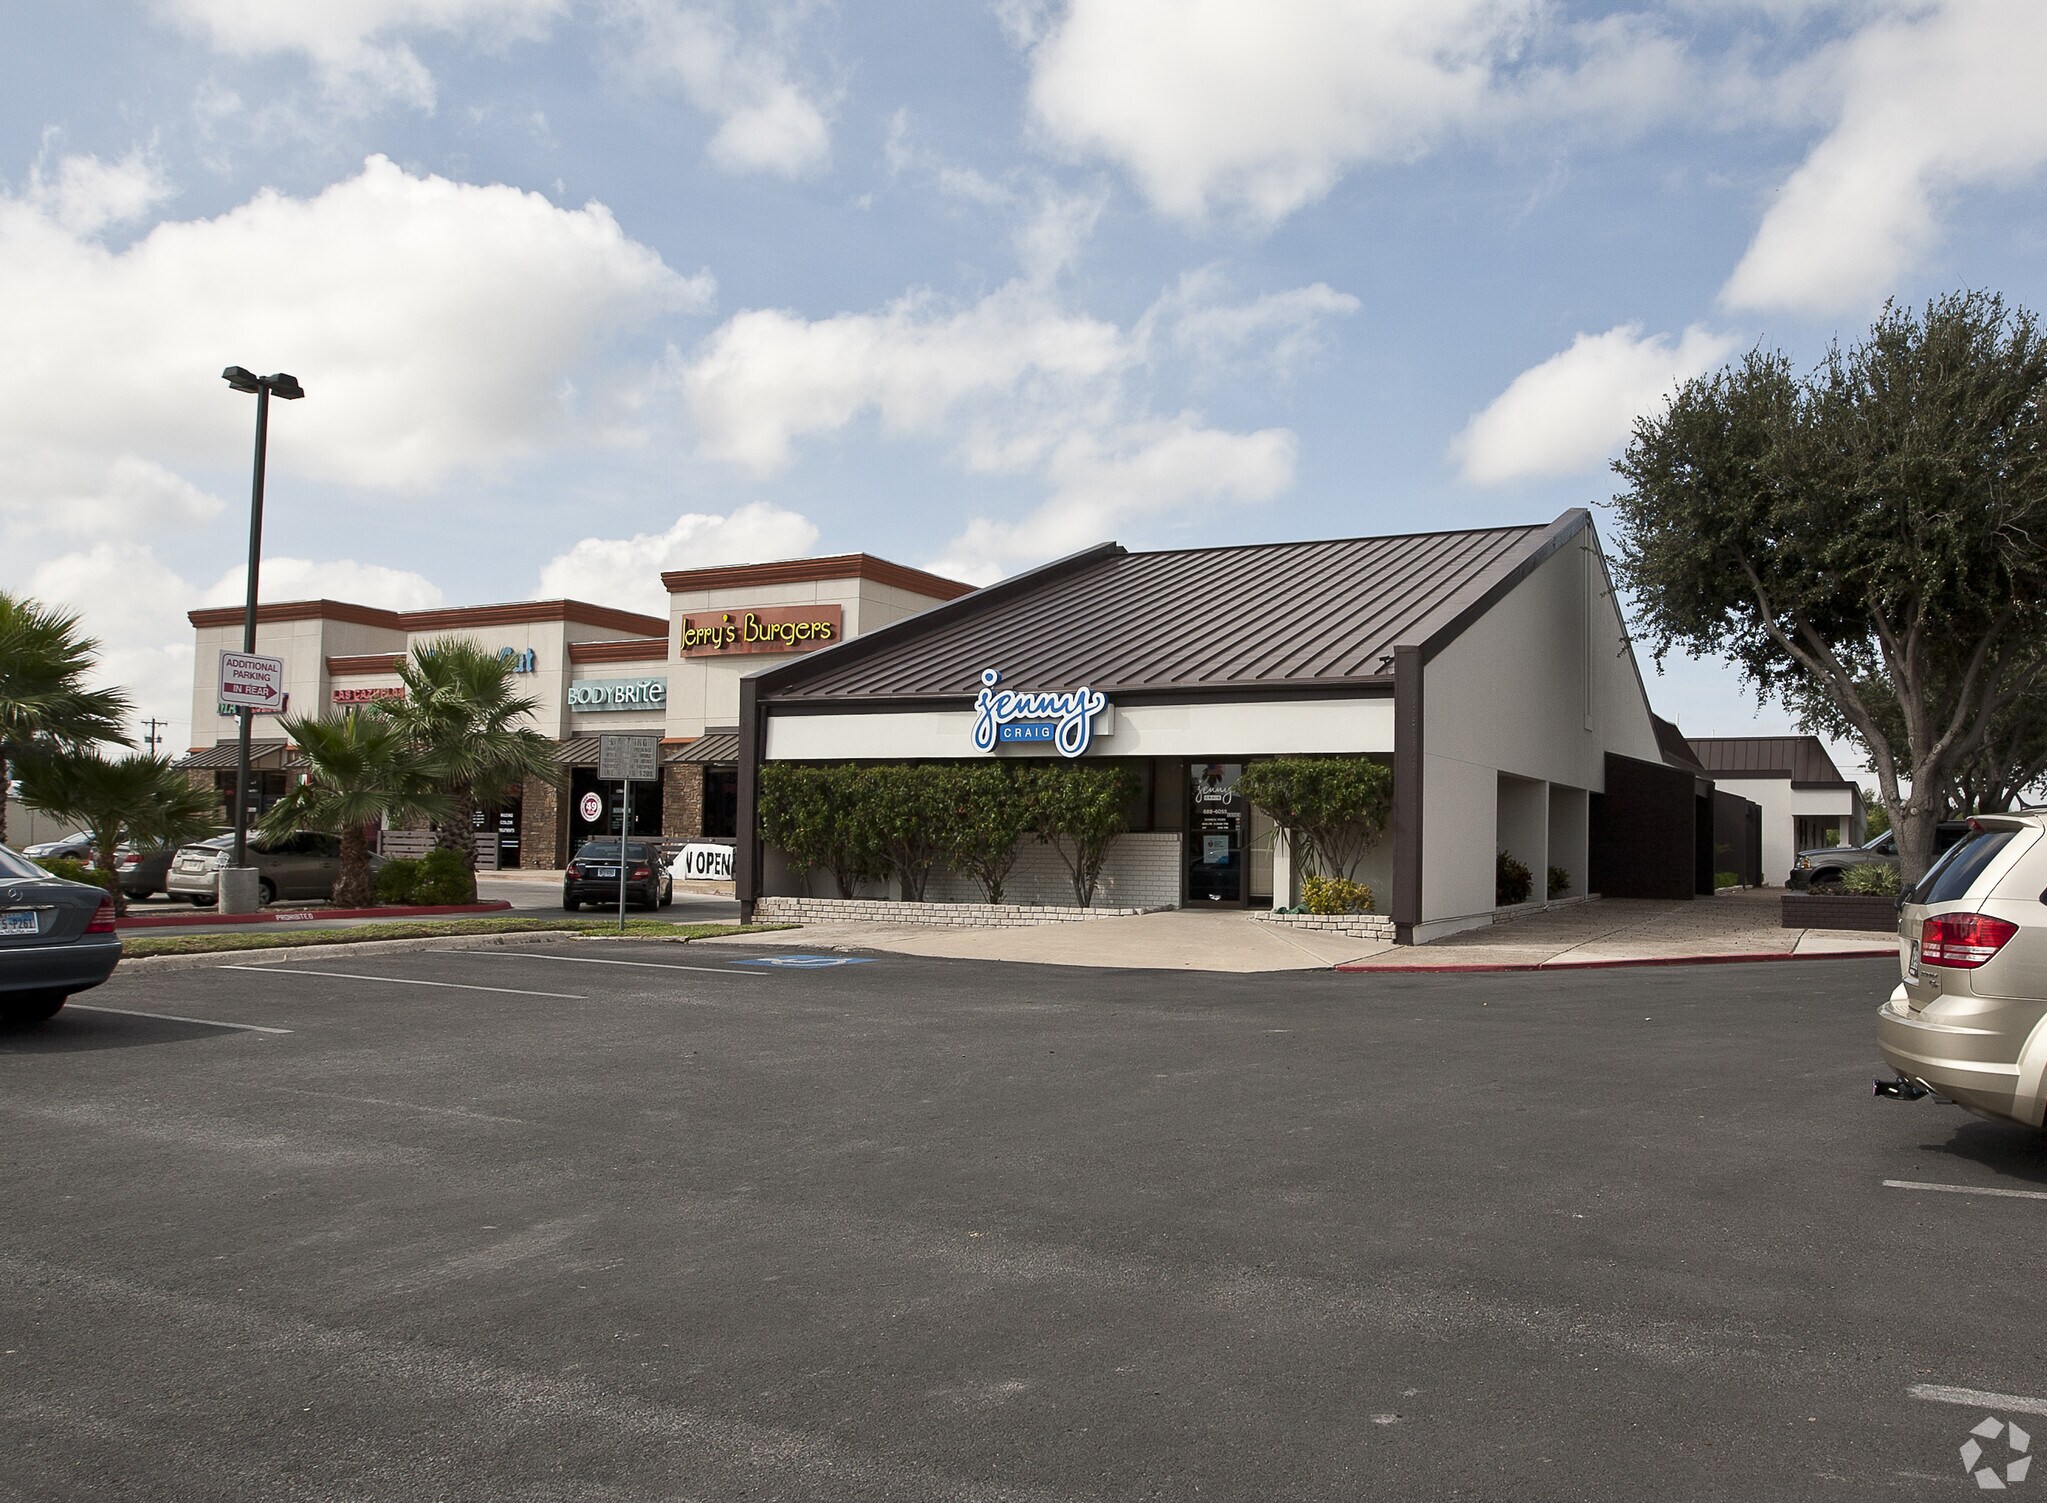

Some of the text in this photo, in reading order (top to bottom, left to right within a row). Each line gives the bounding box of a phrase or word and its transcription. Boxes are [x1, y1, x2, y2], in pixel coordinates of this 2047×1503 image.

[680, 612, 832, 650] Jerry's Burgers
[226, 658, 279, 673] ADDITIONAL
[232, 669, 271, 682] PARKING
[233, 684, 269, 696] IN REAR
[332, 690, 351, 700] LAS
[972, 668, 1106, 758] jenny
[1003, 727, 1050, 738] CRAIG
[696, 851, 731, 875] OPEN
